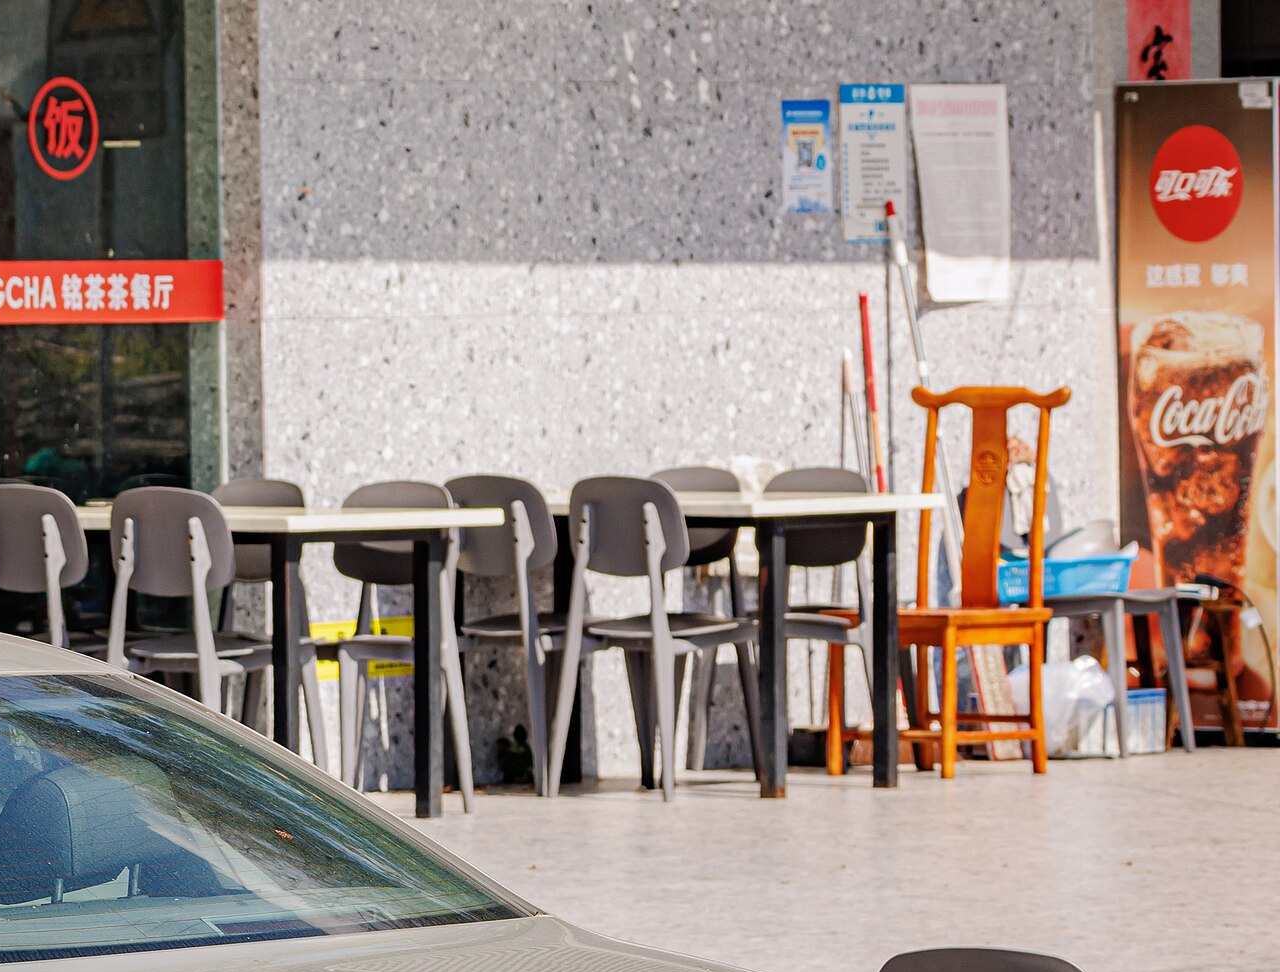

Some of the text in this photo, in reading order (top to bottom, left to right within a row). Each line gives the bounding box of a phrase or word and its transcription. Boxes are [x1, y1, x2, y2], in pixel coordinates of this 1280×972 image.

[44, 96, 86, 160] 饭
[61, 273, 175, 312] 铭茶茶餐厅
